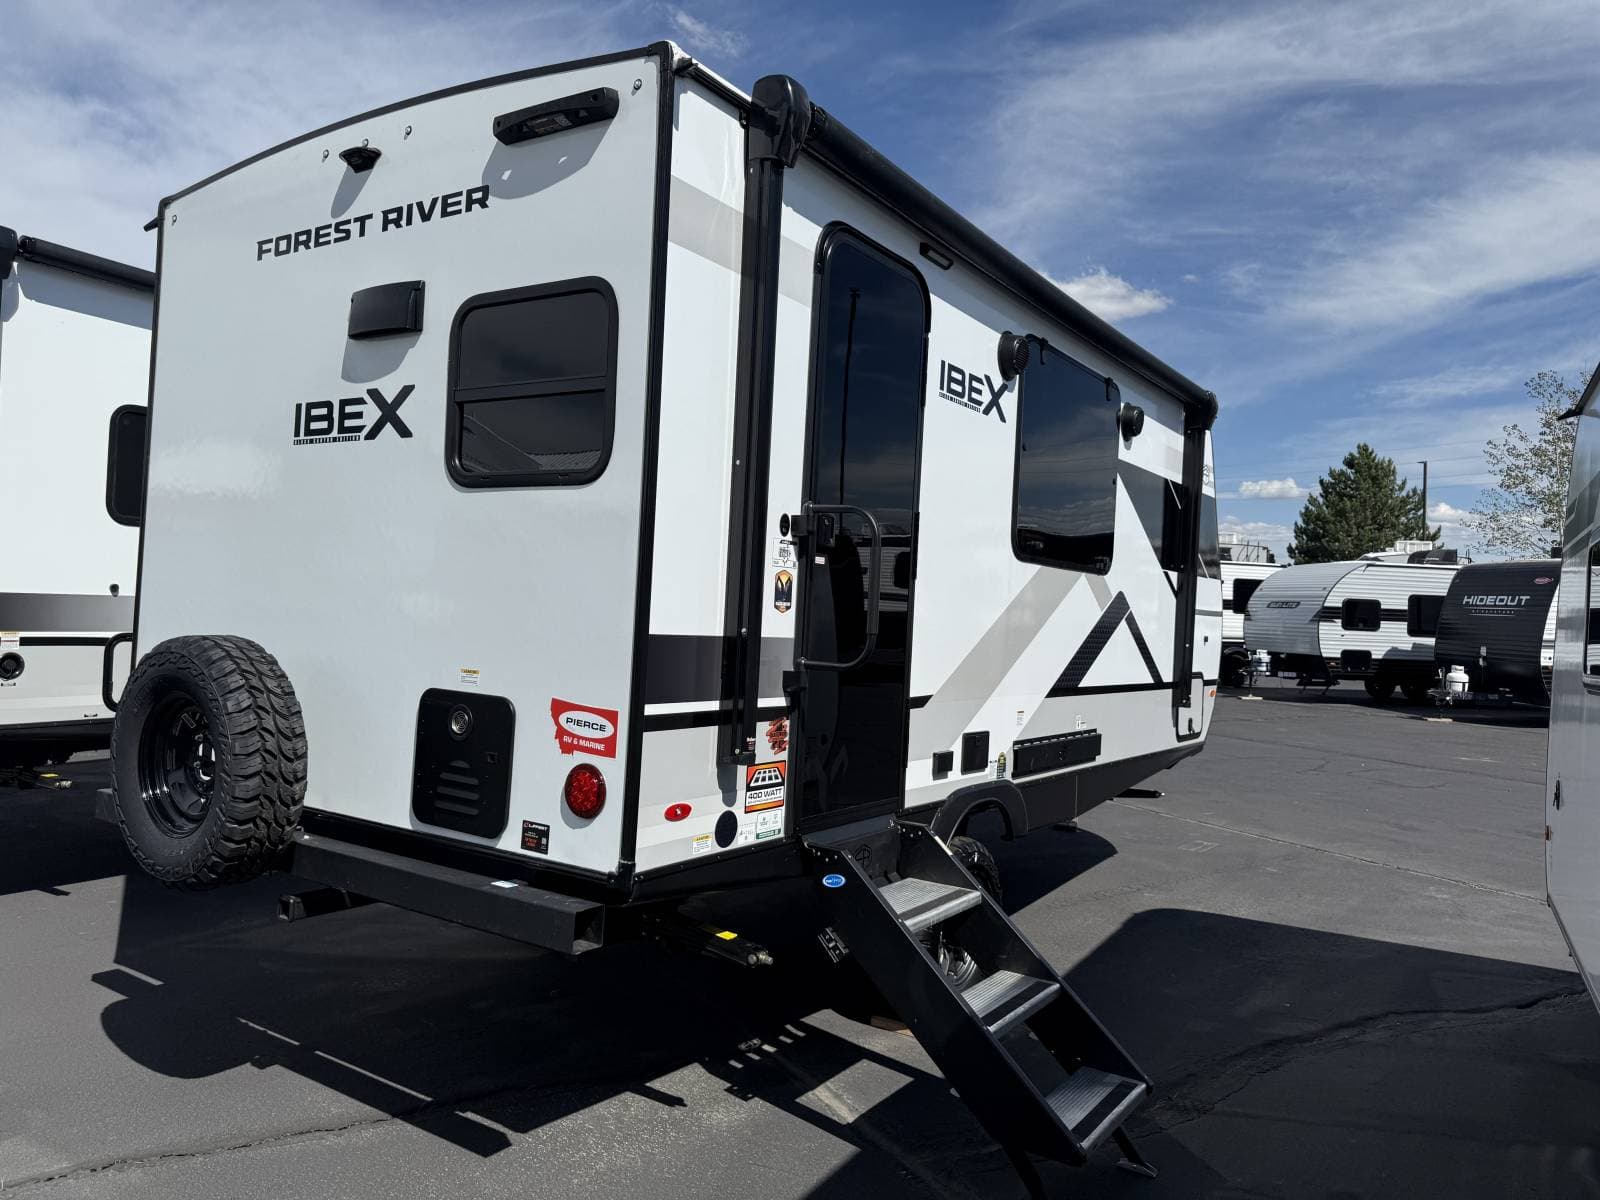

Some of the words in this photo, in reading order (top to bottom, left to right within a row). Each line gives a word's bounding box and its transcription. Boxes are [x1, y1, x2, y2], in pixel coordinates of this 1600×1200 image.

[257, 213, 374, 261] FOREST
[381, 184, 490, 232] RIVER
[939, 360, 1008, 423] IBEX
[294, 384, 415, 440] IBEX
[1462, 595, 1531, 606] HIDEOUT
[565, 716, 607, 732] PIERCE
[563, 735, 573, 744] RV
[579, 739, 605, 751] MARINE
[747, 791, 763, 800] 400
[763, 788, 783, 798] WATT
